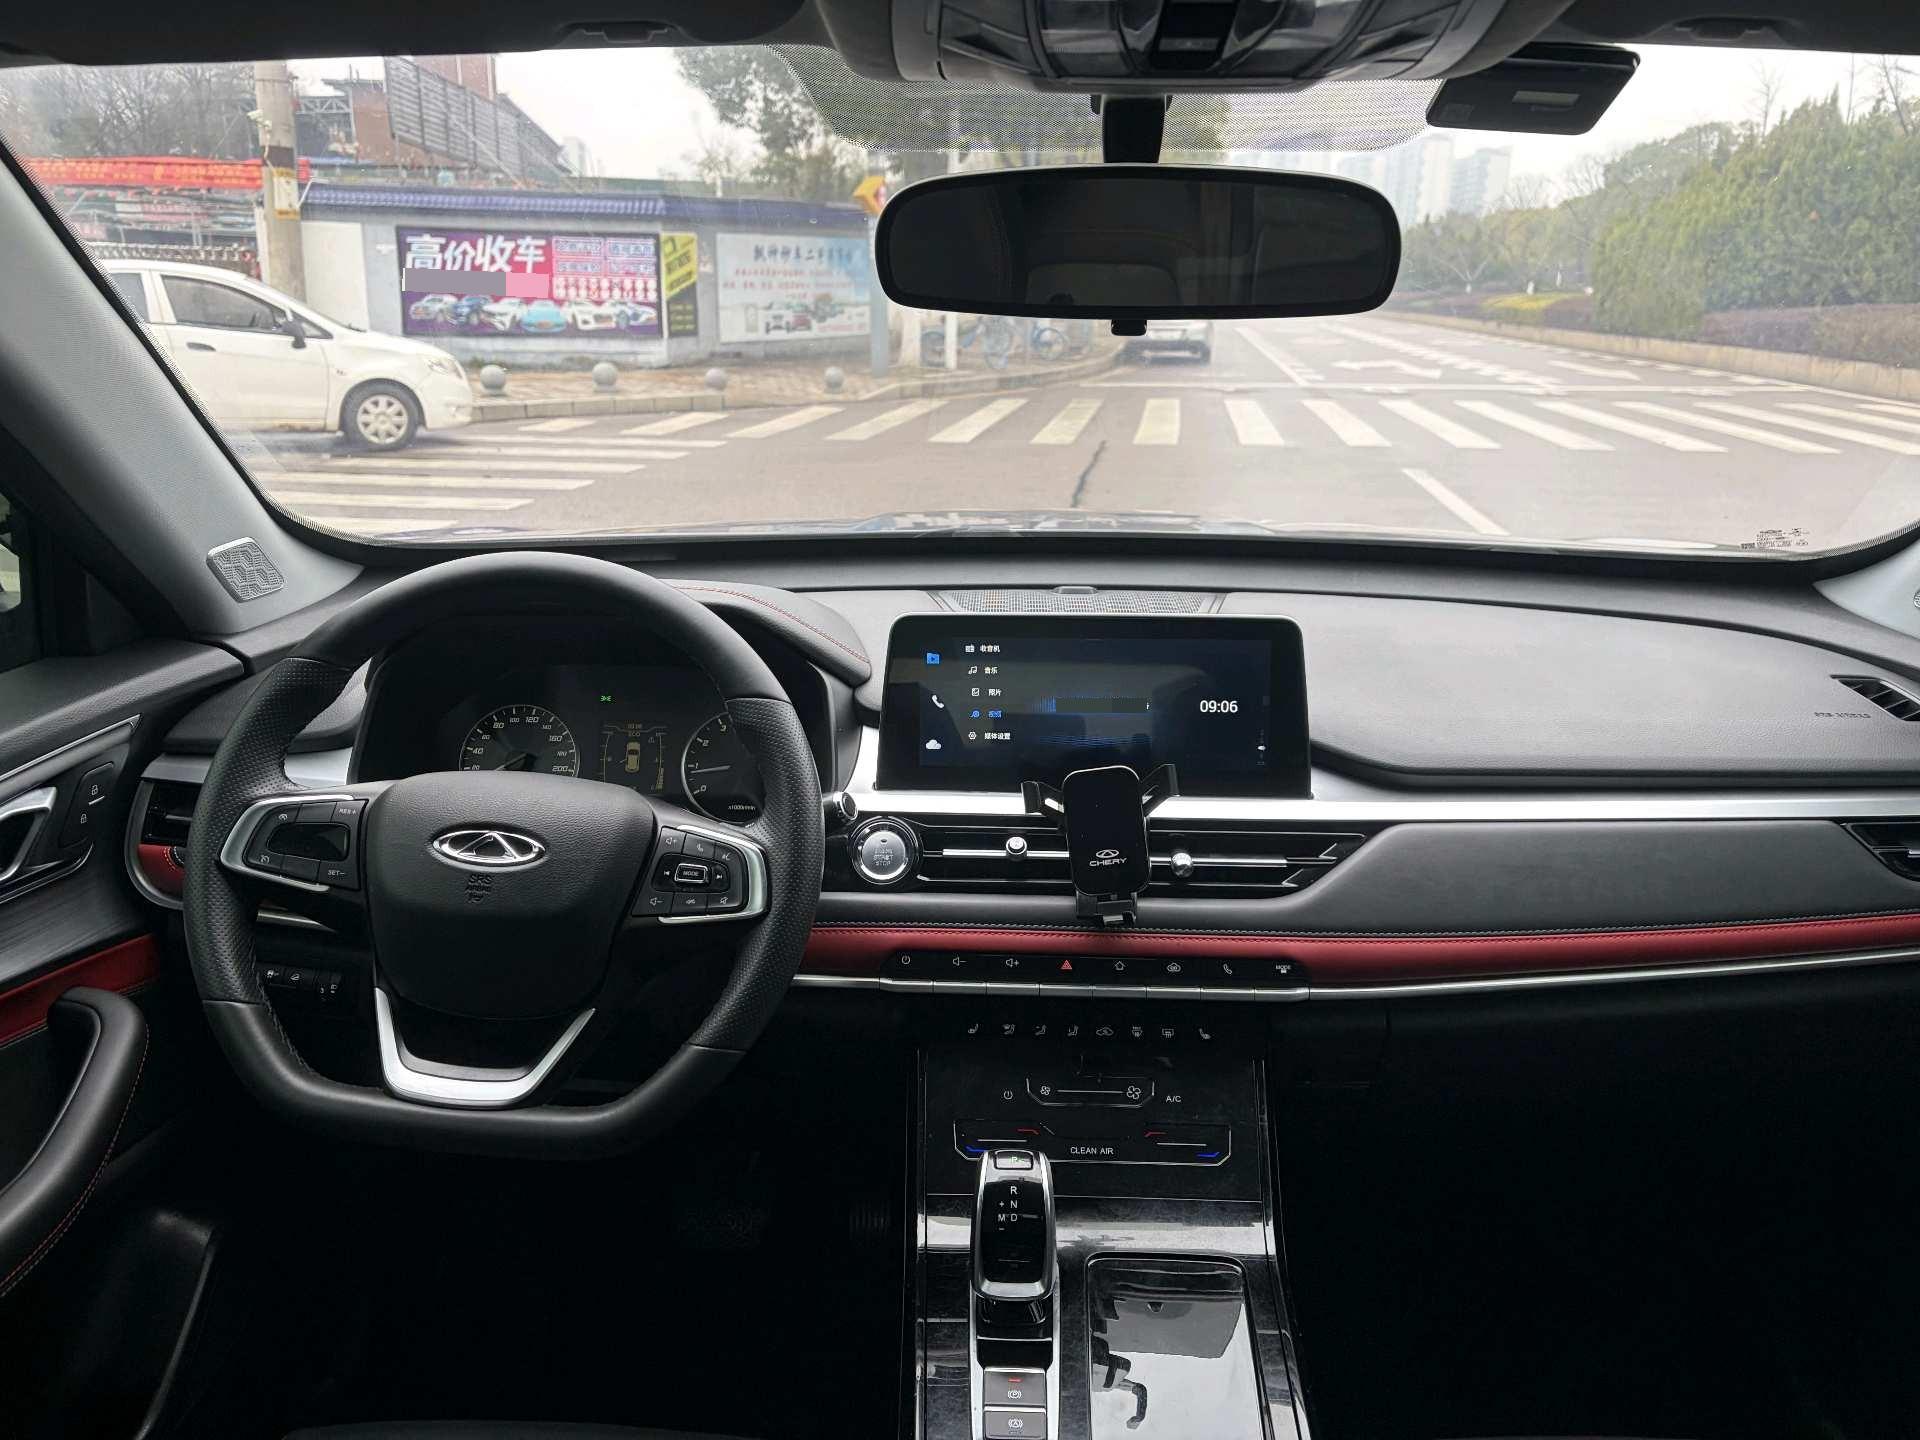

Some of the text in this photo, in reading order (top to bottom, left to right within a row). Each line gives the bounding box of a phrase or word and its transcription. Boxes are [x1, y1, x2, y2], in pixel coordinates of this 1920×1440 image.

[405, 233, 546, 273] 高价收车
[979, 644, 1001, 653] 收音机
[984, 666, 998, 675] 音乐
[988, 688, 1002, 697] 照片
[1199, 700, 1239, 713] 09:06
[984, 732, 1011, 741] 媒体设置
[472, 747, 484, 755] 40
[1089, 857, 1128, 867] CHERY
[1165, 1095, 1182, 1103] A/C
[1070, 1146, 1114, 1155] CLEAN AIR
[1010, 1185, 1018, 1195] R
[1010, 1199, 1018, 1209] N
[997, 1213, 1018, 1222] M D
